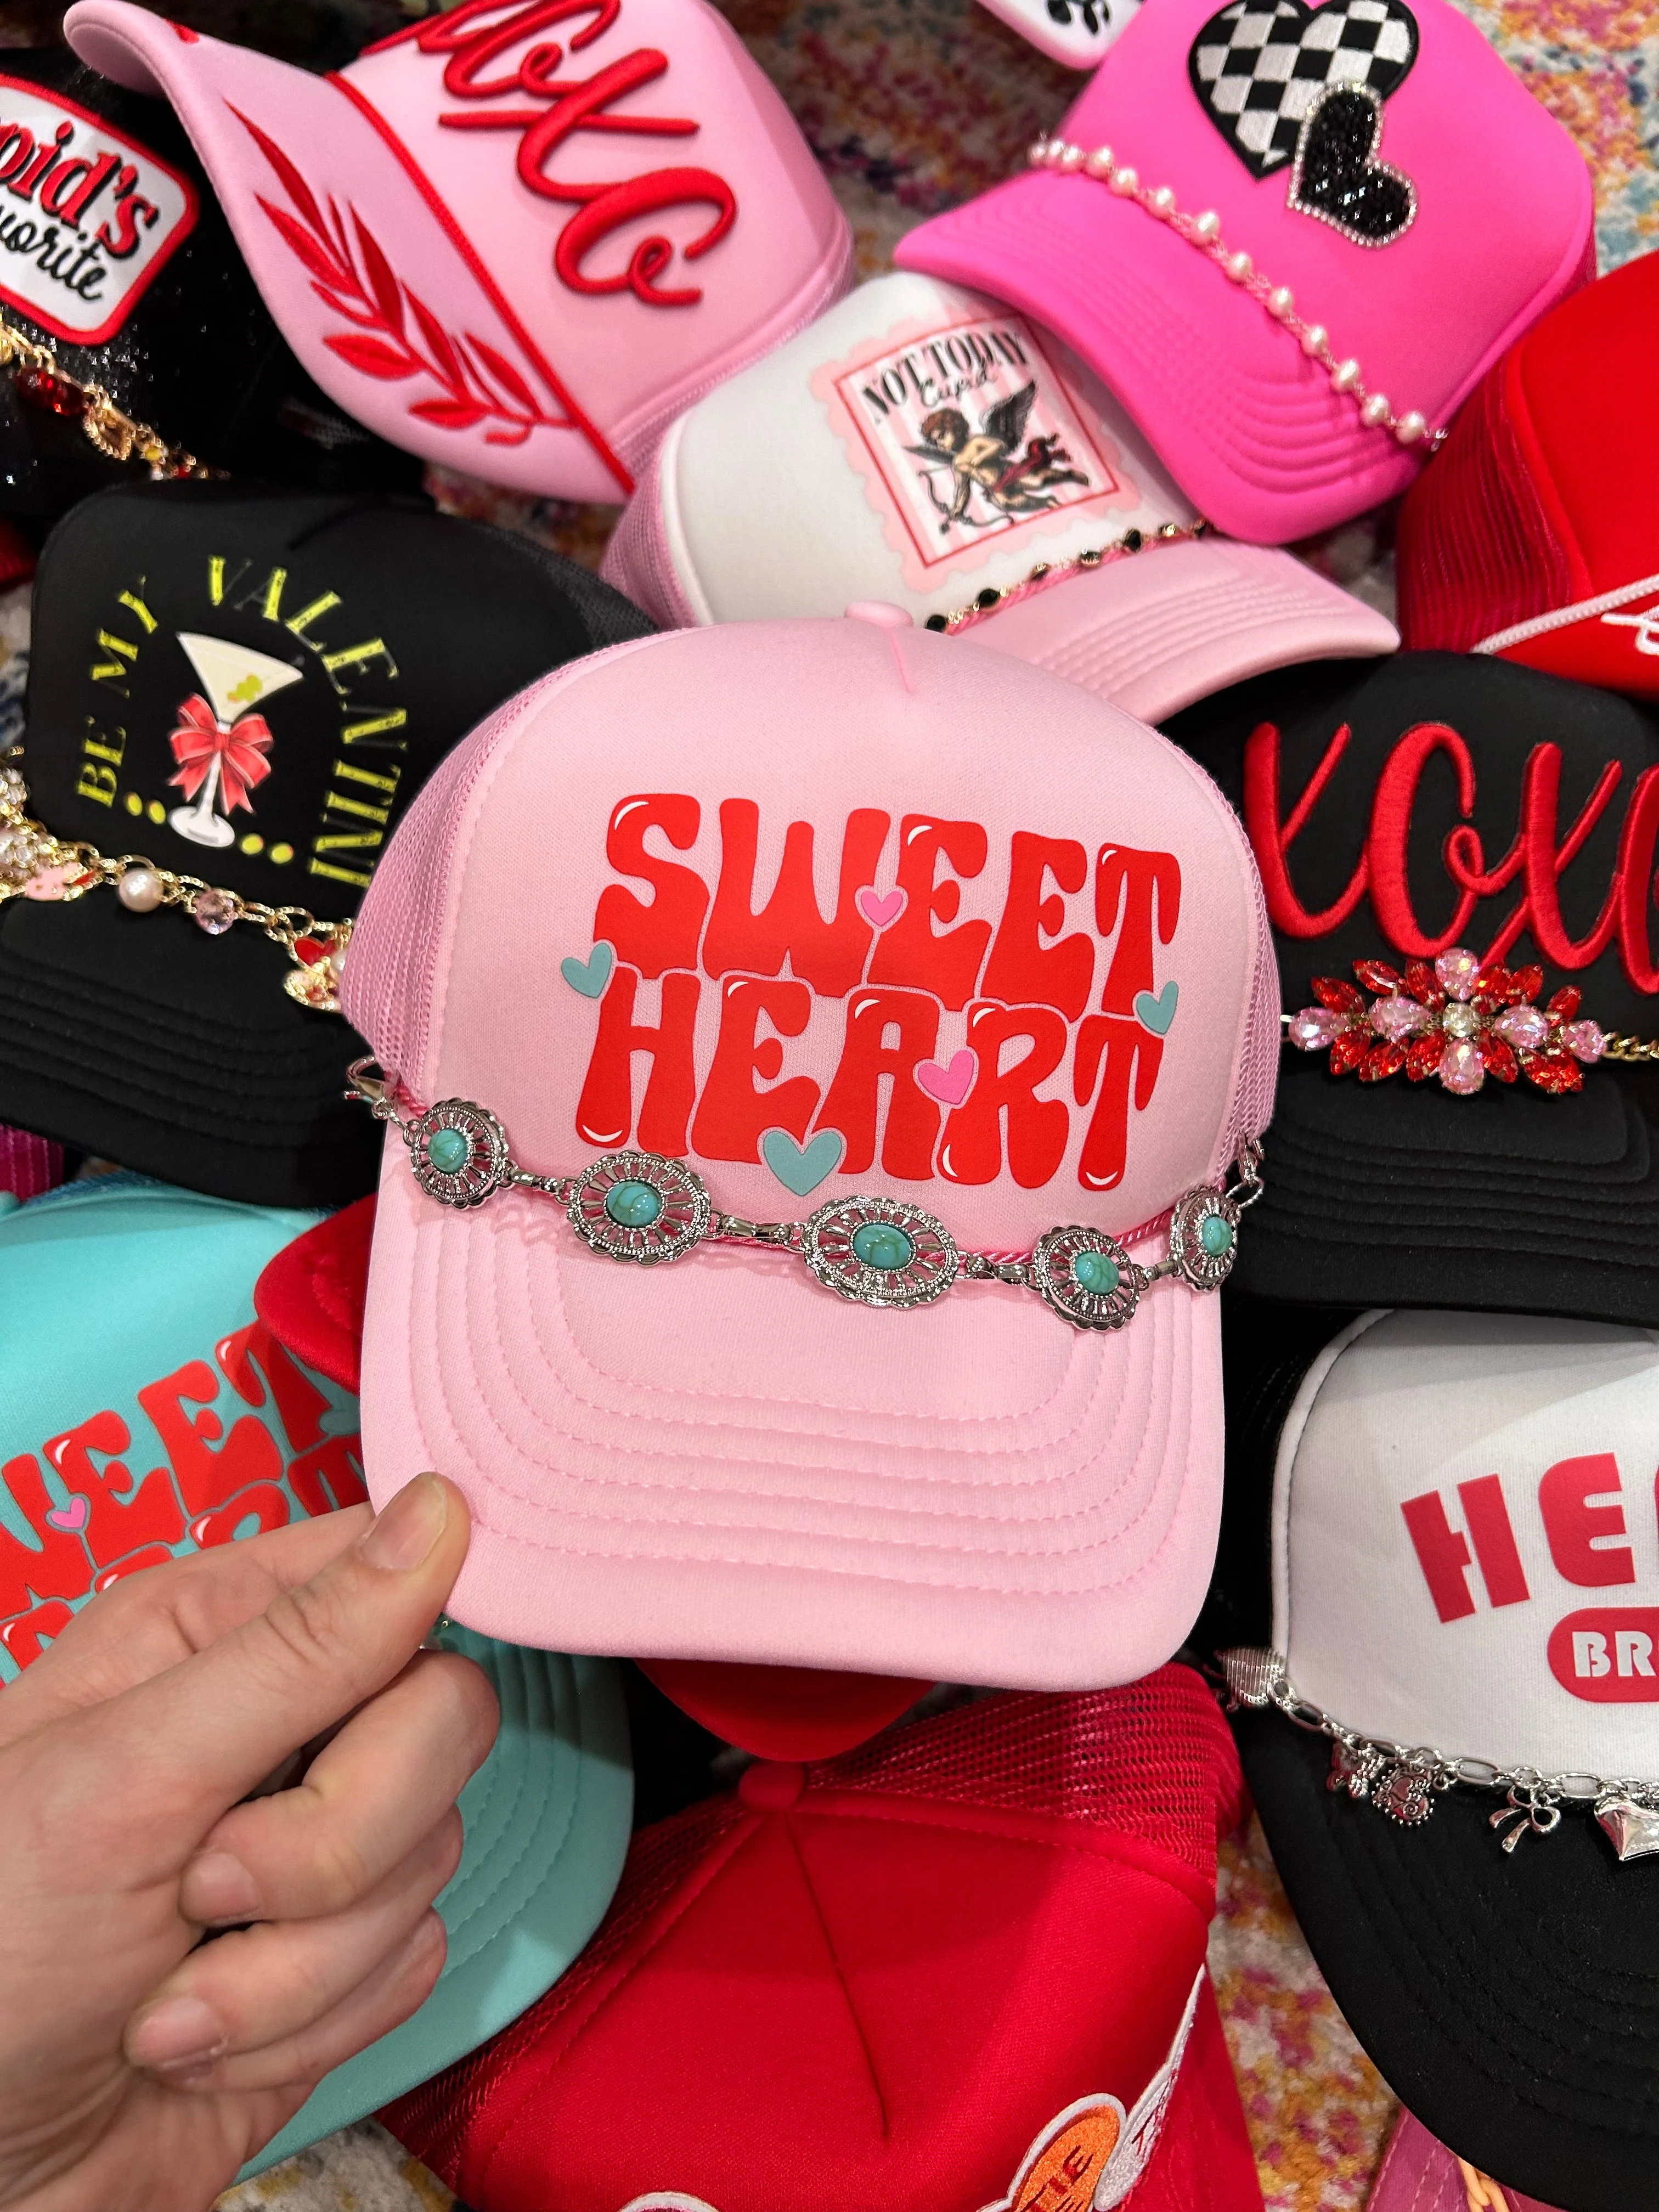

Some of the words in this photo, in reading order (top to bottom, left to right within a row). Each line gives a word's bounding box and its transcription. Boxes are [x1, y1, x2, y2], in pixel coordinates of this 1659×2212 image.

[862, 351, 923, 425] NOT
[922, 331, 1027, 380] TODAY
[921, 357, 998, 408] Cupid
[89, 574, 159, 699] MY
[75, 715, 127, 809] BE
[593, 792, 1182, 1023] SWEET
[575, 965, 1165, 1192] HEART
